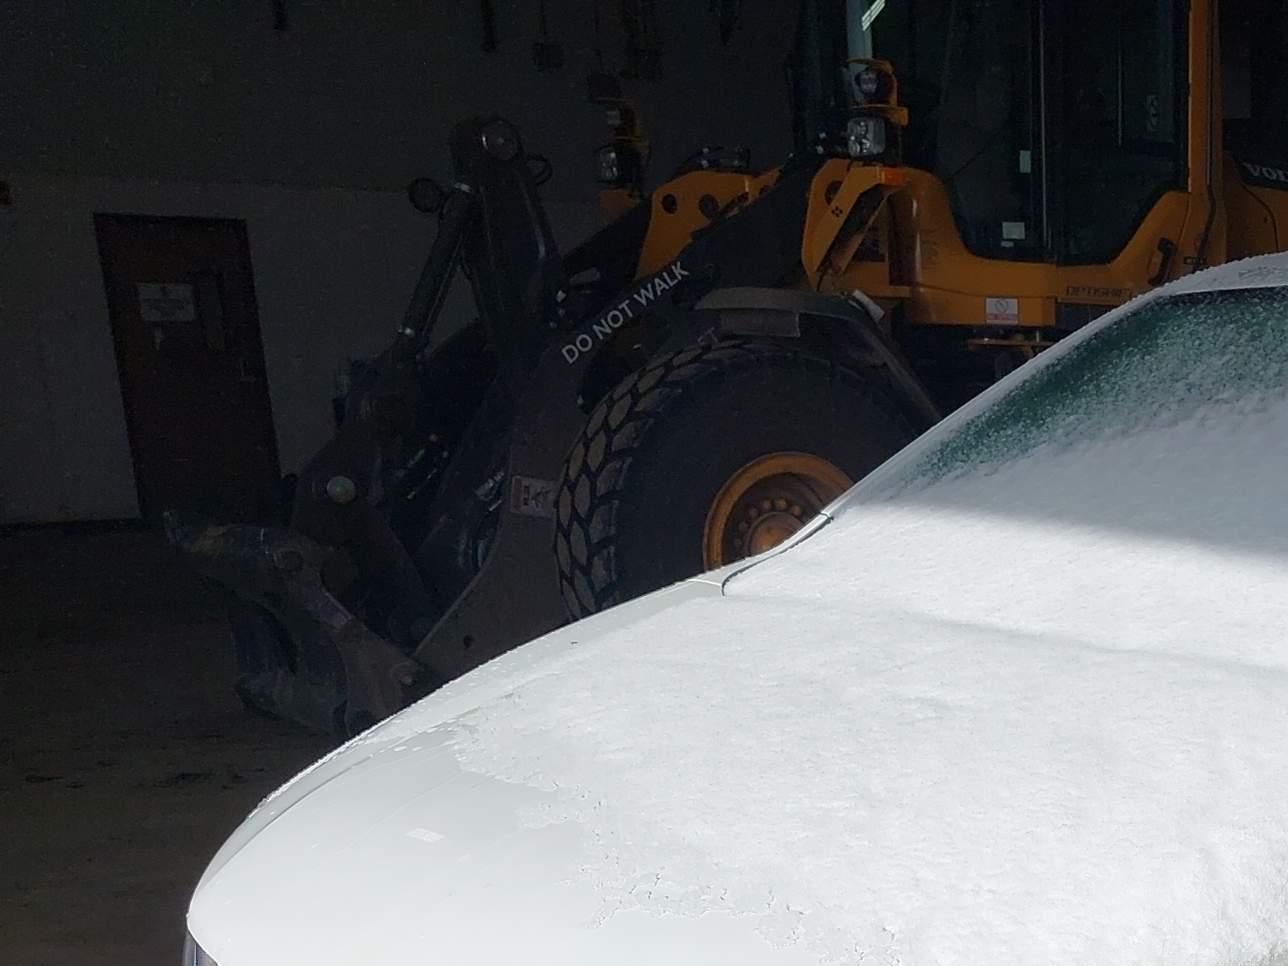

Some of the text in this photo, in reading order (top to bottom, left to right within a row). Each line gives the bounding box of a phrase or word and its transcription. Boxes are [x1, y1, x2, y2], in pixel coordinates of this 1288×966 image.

[561, 260, 690, 365] DO NOT WALK
